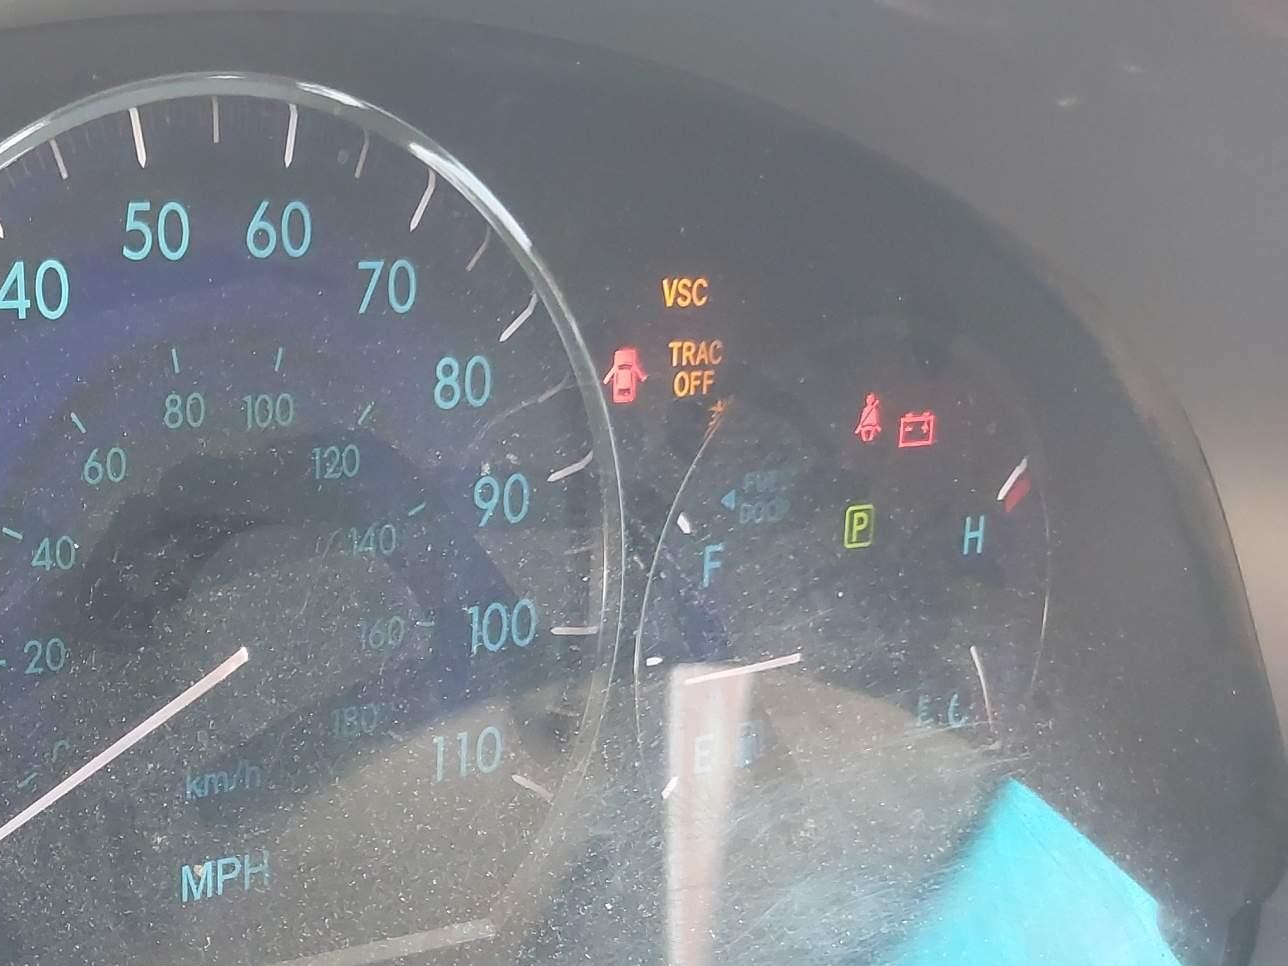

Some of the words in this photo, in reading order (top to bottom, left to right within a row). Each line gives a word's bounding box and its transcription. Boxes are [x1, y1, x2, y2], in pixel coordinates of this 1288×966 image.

[122, 201, 190, 261] 50
[246, 199, 312, 258] 60
[358, 258, 417, 315] 70
[662, 278, 709, 308] VSC
[668, 340, 724, 367] TRAC
[434, 356, 492, 412] 80
[673, 370, 715, 397] OFF
[164, 392, 205, 429] 80
[243, 392, 294, 430] 100
[83, 447, 127, 485] 60
[312, 443, 360, 480] 120
[473, 472, 530, 527] 90
[31, 535, 76, 571] 40
[348, 523, 397, 557] 140
[963, 515, 985, 555] H
[703, 544, 724, 588] F
[466, 598, 537, 655] 100
[23, 637, 66, 675] 20
[432, 726, 503, 783] 110
[181, 849, 271, 902] MPH
